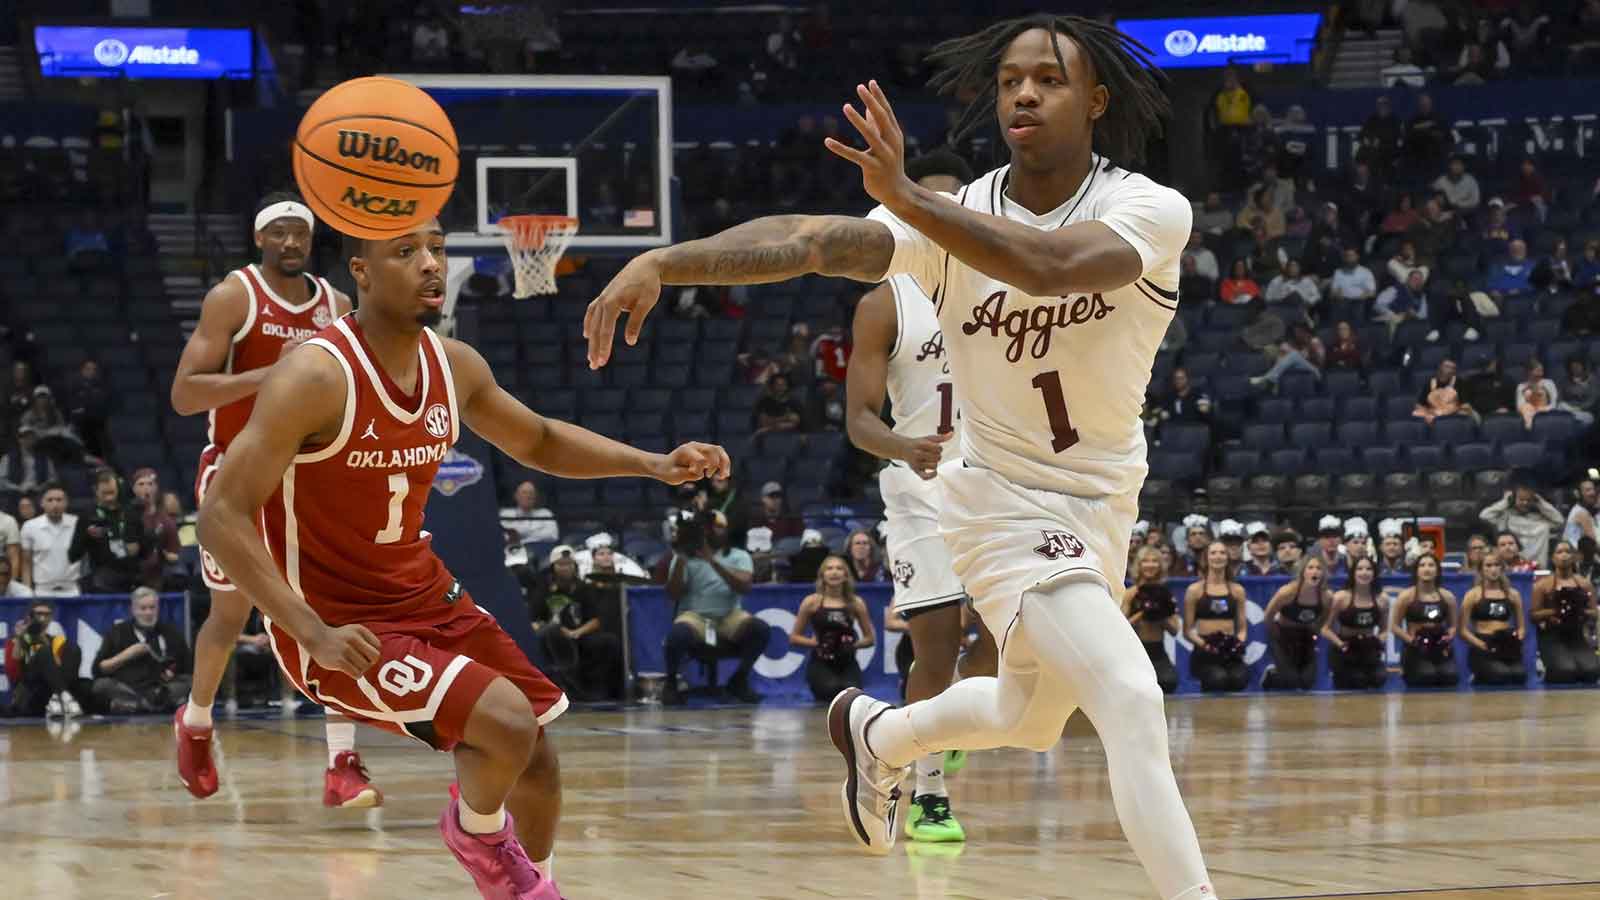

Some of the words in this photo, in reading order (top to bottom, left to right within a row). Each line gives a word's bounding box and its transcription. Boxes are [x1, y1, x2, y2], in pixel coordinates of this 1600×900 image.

[127, 45, 199, 65] Allstate
[1197, 33, 1266, 53] Allstate
[337, 129, 440, 175] Wilson
[341, 186, 418, 216] NCAA
[962, 290, 1115, 363] Aggies
[1031, 370, 1080, 454] 1
[346, 441, 448, 468] OKLAHOMA
[374, 472, 409, 544] 1
[377, 654, 433, 697] OU
